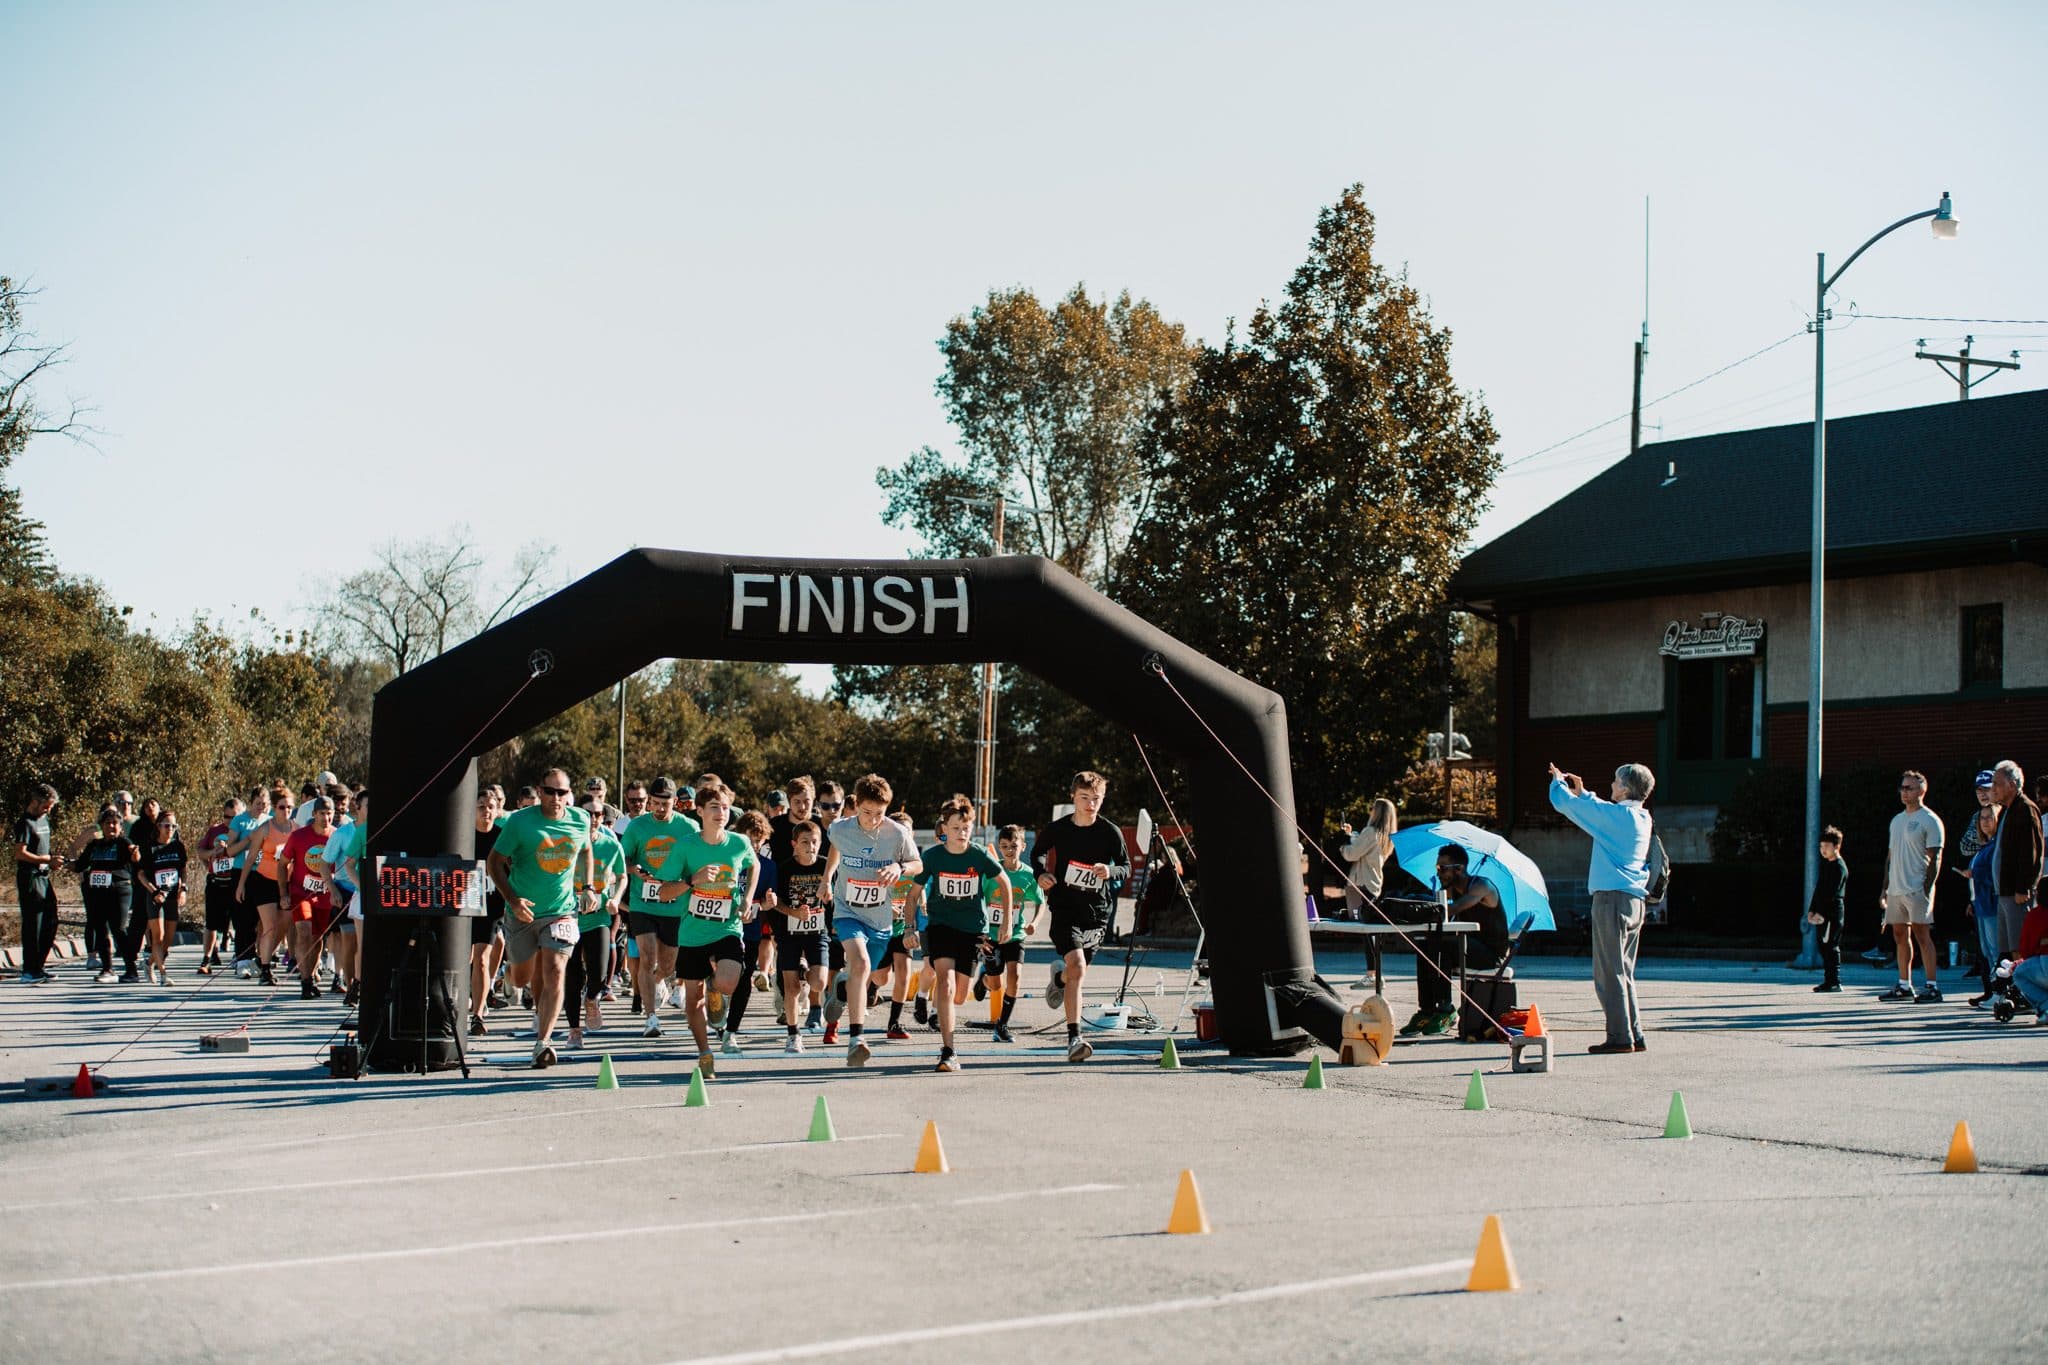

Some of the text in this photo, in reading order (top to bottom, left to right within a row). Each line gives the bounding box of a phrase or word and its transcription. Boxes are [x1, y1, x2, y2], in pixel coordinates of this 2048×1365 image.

[732, 574, 968, 634] FINISH
[216, 859, 230, 870] 729
[843, 857, 862, 868] ROSS
[308, 879, 324, 890] 784
[1074, 869, 1097, 887] 748
[854, 886, 879, 902] 779
[947, 880, 971, 895] 610
[696, 899, 723, 916] 692
